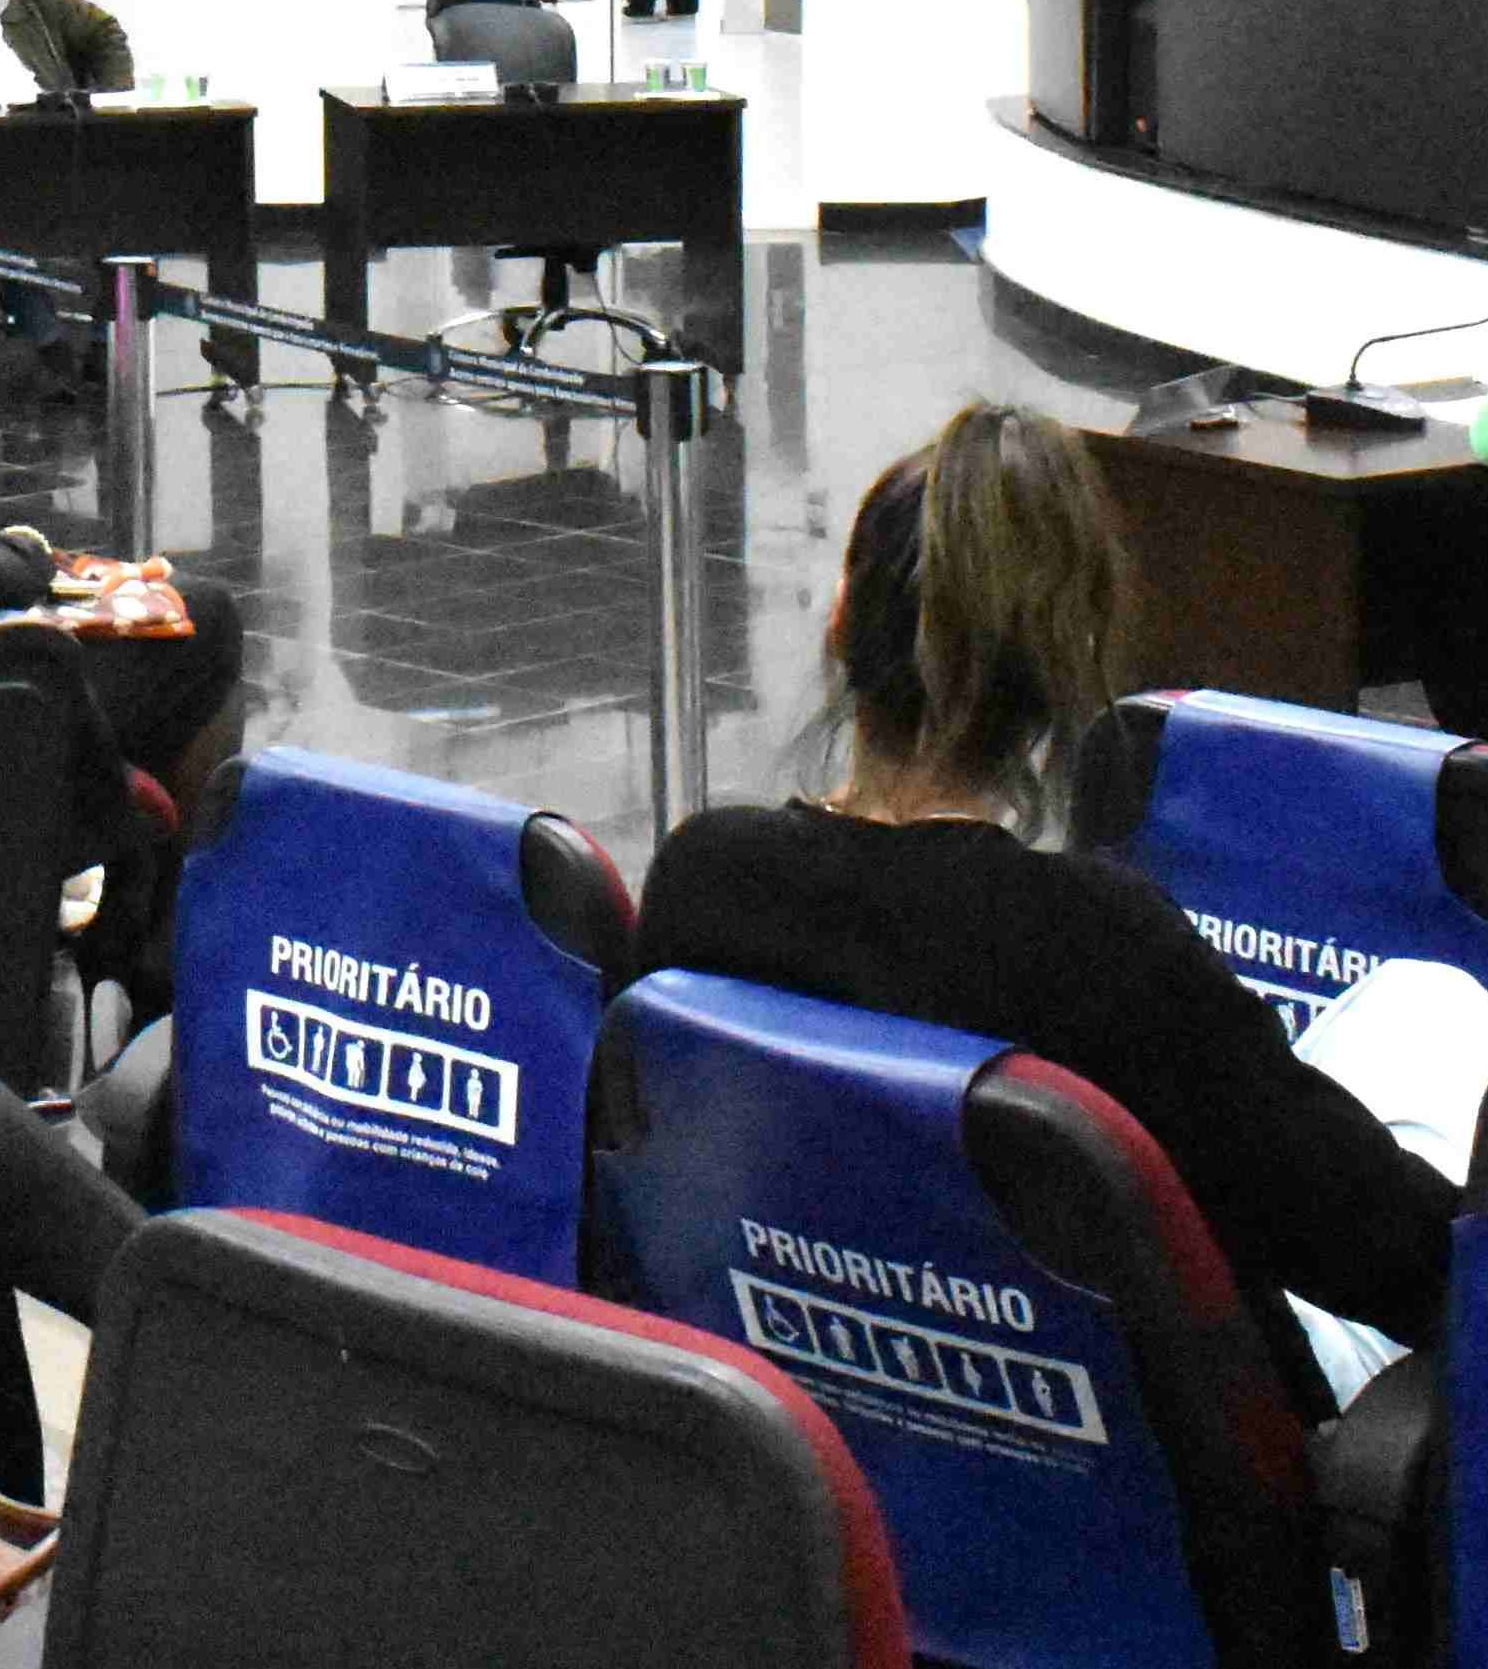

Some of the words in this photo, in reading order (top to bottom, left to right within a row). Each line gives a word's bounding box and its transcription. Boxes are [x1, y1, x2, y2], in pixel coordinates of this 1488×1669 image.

[270, 933, 491, 1032] PRIORITÁRIO
[1182, 906, 1380, 986] RIORITÁR
[740, 1216, 1037, 1333] PRIORITÁRIO
